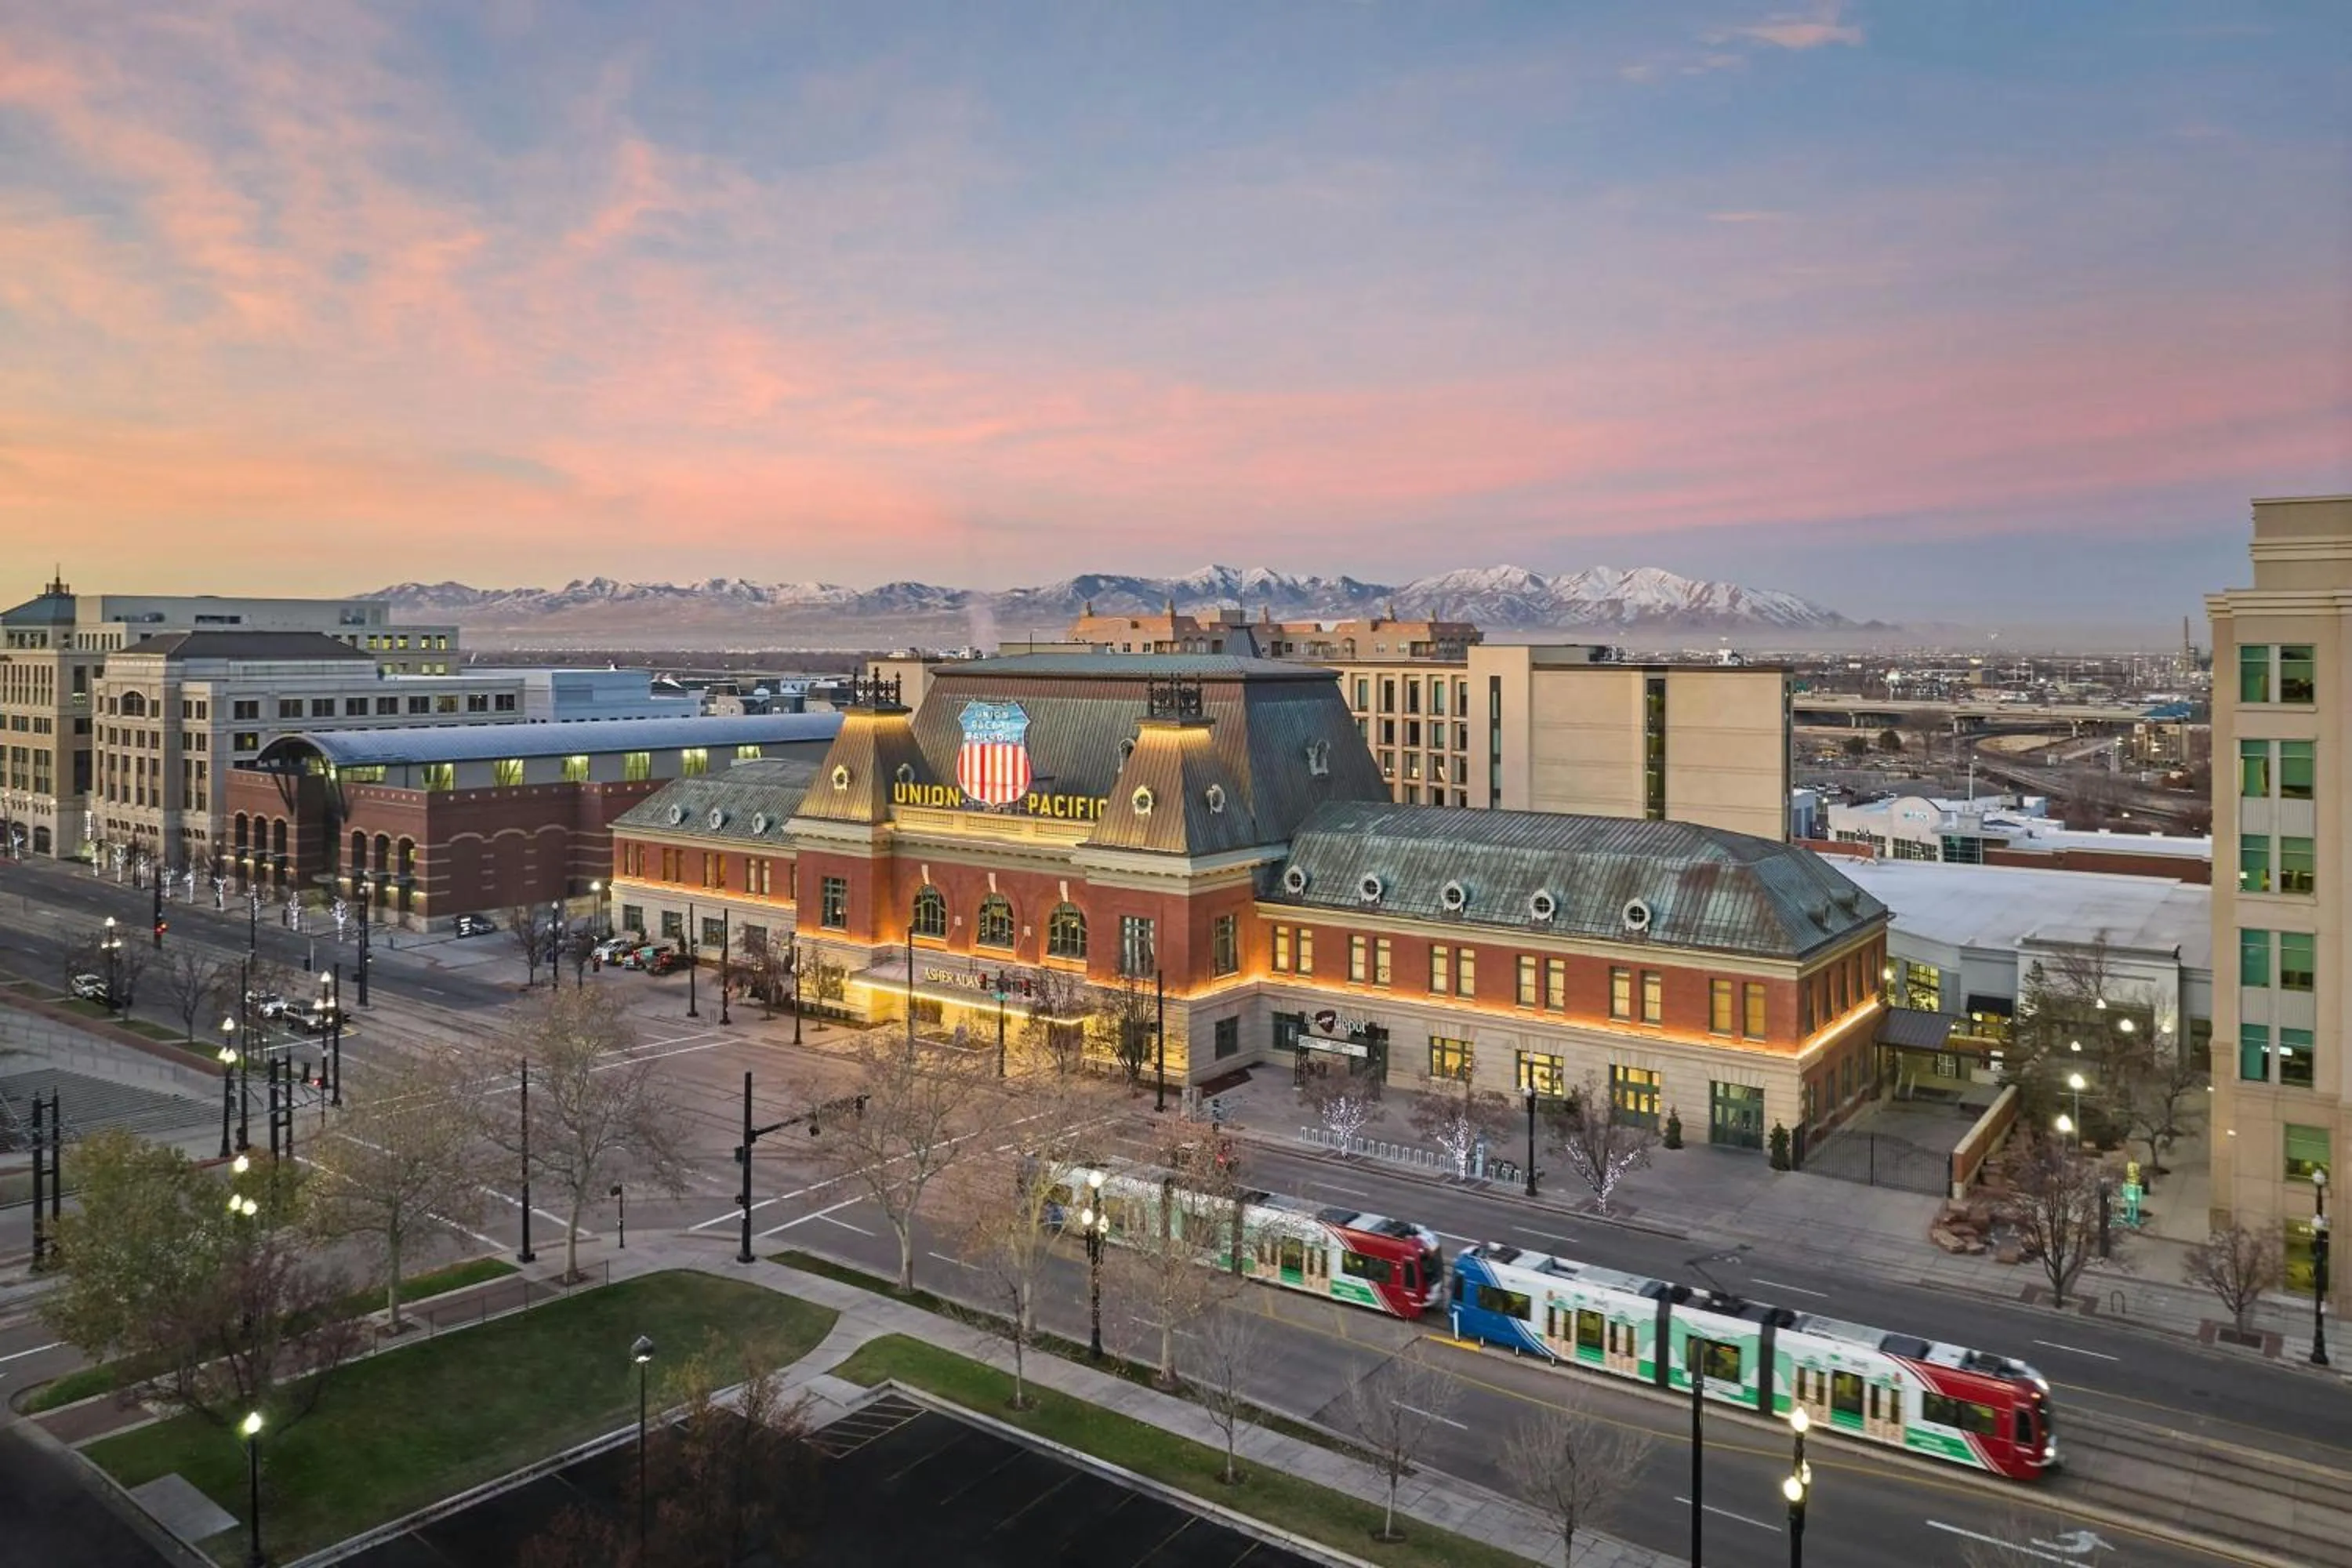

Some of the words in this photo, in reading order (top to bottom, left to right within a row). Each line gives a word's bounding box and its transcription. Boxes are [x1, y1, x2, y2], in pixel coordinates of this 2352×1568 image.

[895, 782, 960, 807] UNION
[924, 967, 954, 984] ASHER
[1334, 1015, 1367, 1036] depot
